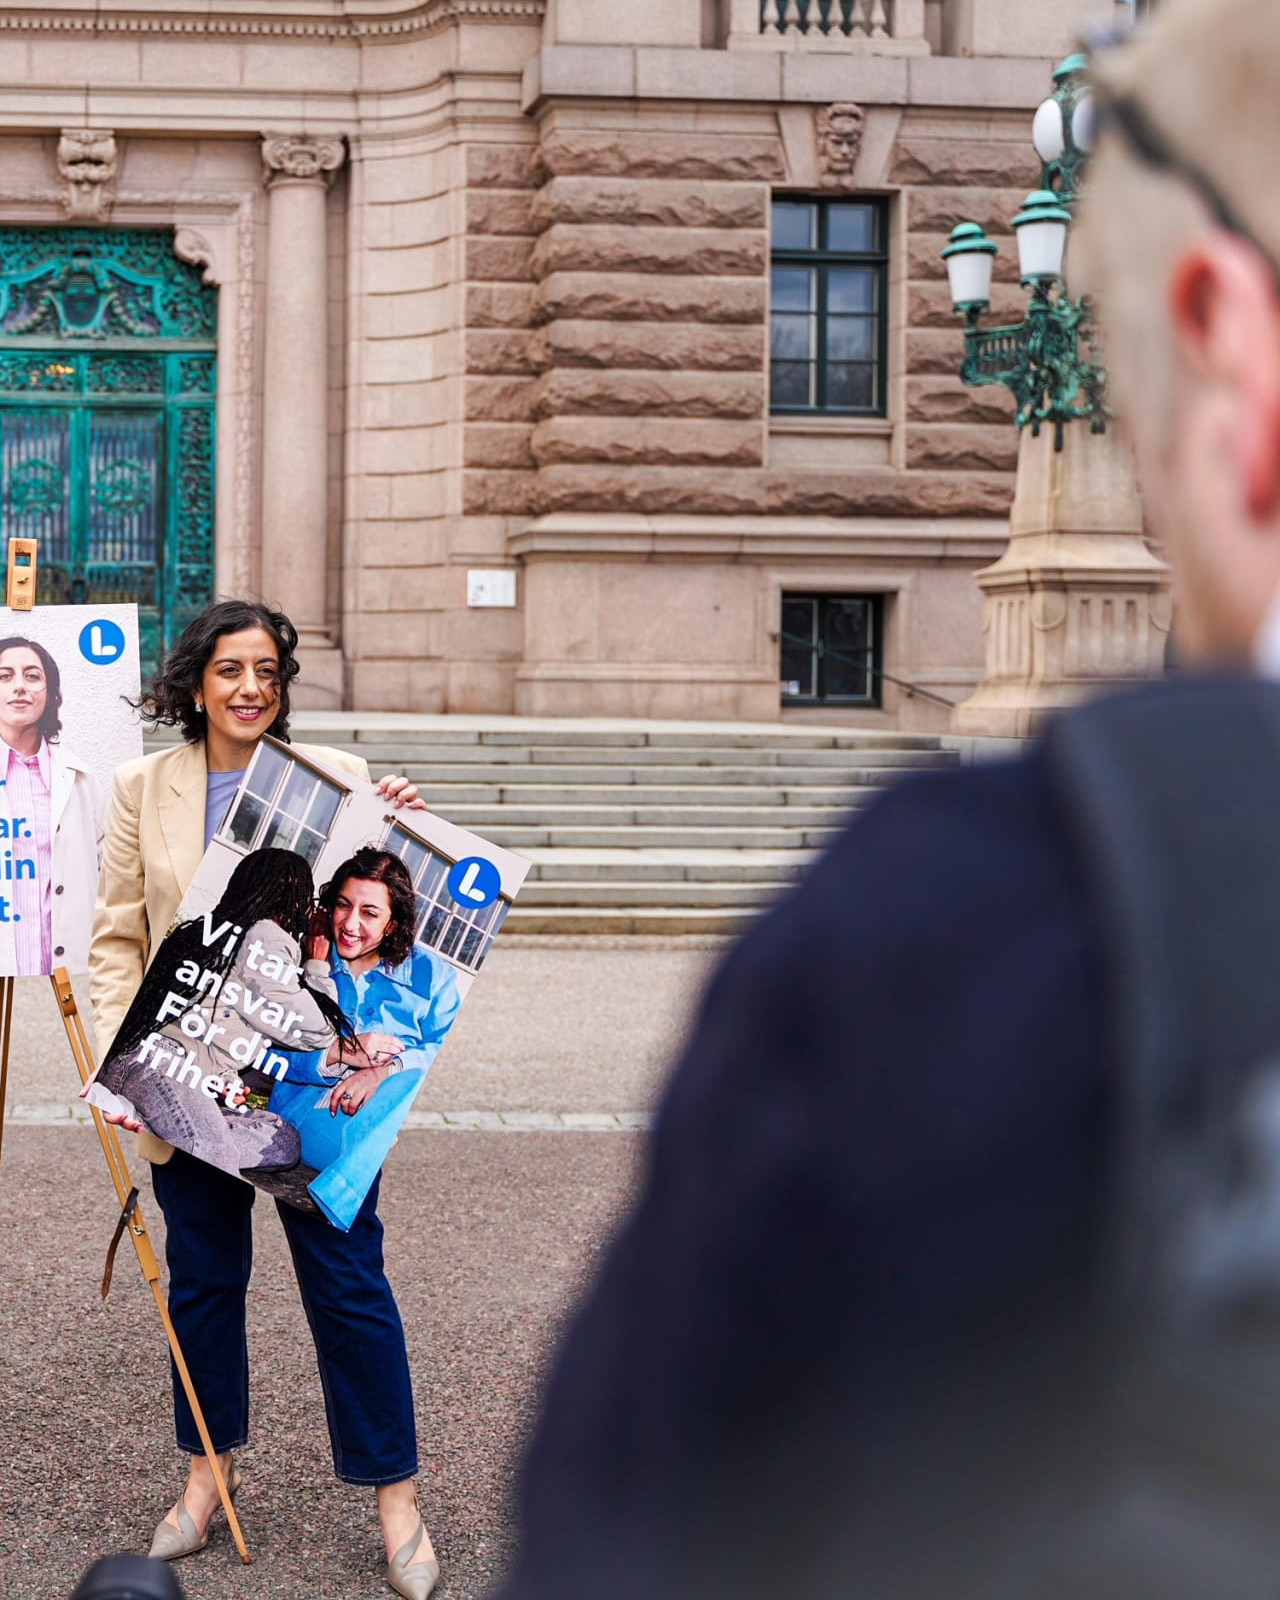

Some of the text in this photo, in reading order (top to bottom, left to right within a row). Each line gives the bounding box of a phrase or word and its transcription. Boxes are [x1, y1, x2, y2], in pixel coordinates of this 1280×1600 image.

[91, 625, 118, 656] L
[458, 862, 486, 902] L
[201, 911, 305, 986] Vi tar
[155, 991, 290, 1082] För din
[175, 959, 305, 1039] ansvar.
[136, 1031, 248, 1114] frihet.
